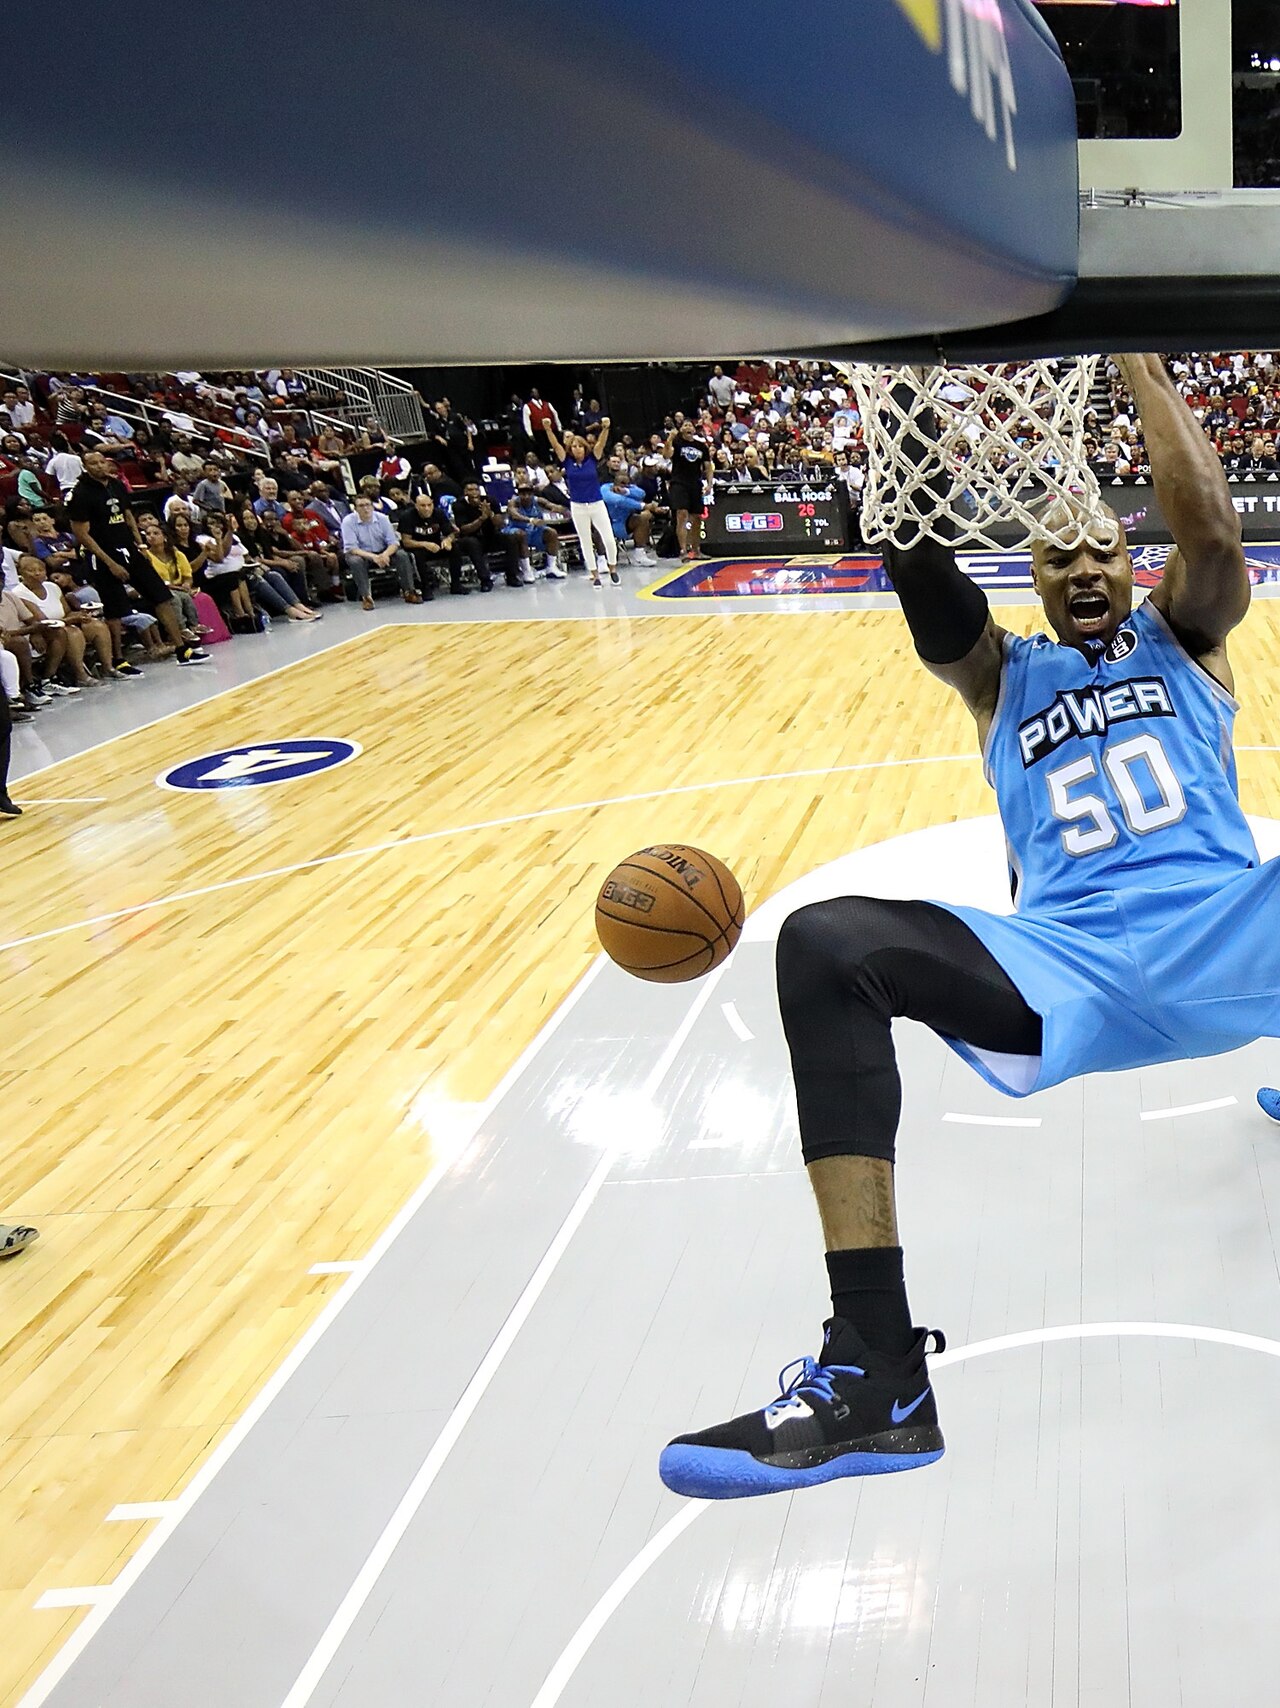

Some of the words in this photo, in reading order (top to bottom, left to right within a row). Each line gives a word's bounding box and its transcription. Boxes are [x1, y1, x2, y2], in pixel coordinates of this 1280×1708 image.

[774, 492, 800, 503] BALL
[802, 491, 833, 501] HOGS
[798, 504, 815, 517] 26
[1018, 681, 1174, 765] POWER
[1046, 733, 1188, 858] 50
